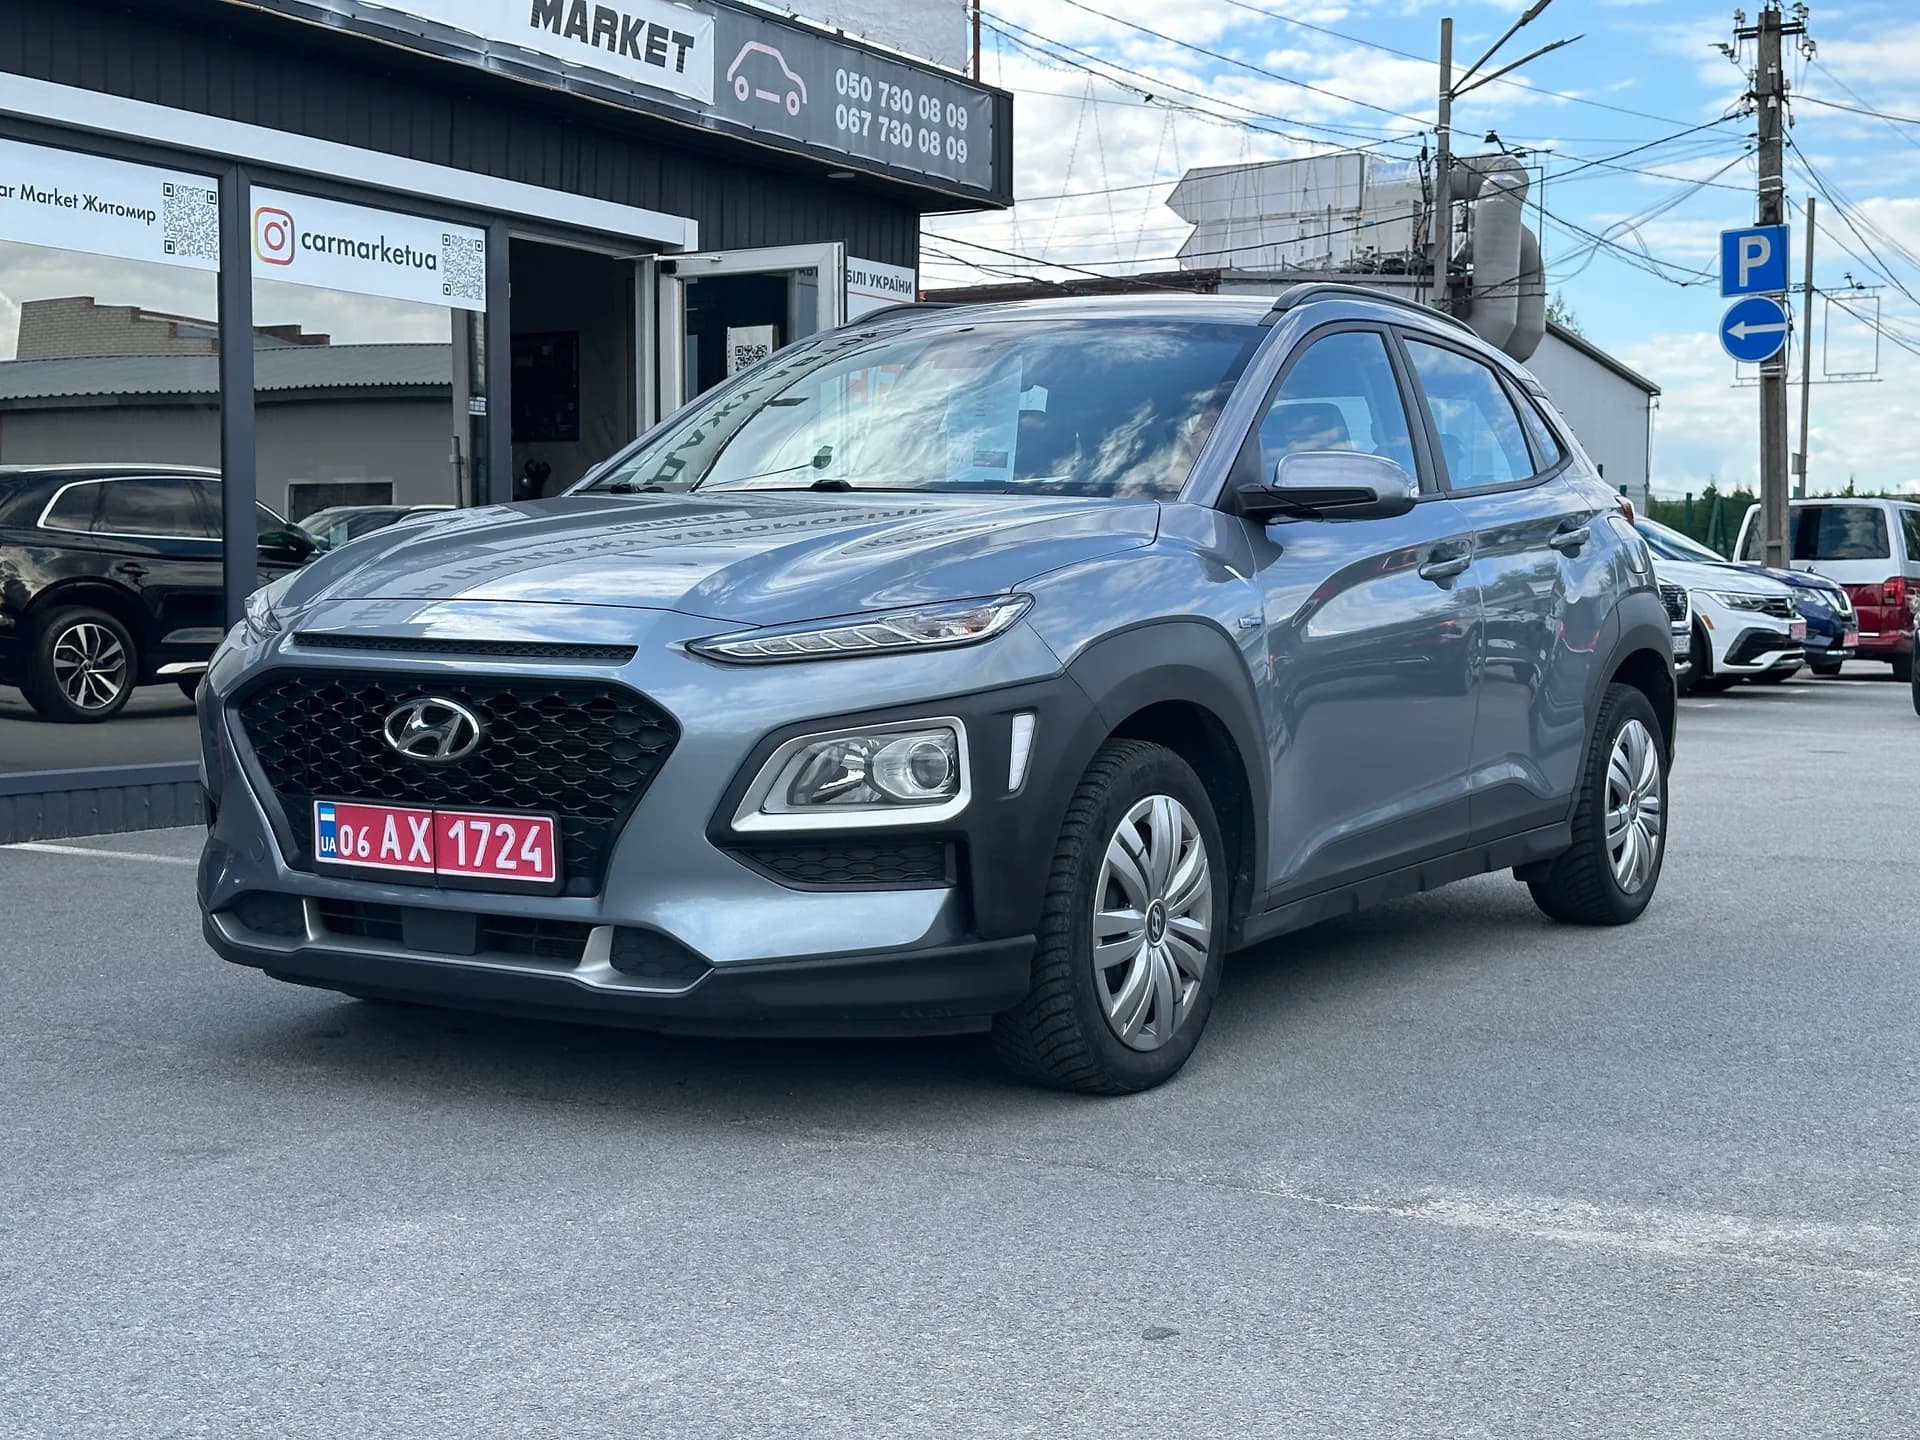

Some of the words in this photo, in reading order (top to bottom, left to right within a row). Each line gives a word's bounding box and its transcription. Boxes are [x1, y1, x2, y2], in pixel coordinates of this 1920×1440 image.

[530, 0, 695, 74] MARKET
[835, 68, 872, 102] 050
[878, 81, 913, 115] 730
[918, 94, 941, 123] 08
[946, 103, 968, 131] 09
[835, 104, 872, 137] 067
[878, 115, 913, 148] 730
[918, 127, 941, 156] 08
[945, 136, 968, 164] 09
[20, 183, 78, 209] Market
[83, 194, 157, 226] Житомир
[301, 231, 437, 271] carmarketua
[1739, 235, 1771, 287] P
[870, 275, 912, 295] УКРАЇНИ
[321, 836, 336, 853] UA
[339, 824, 371, 858] 06
[448, 820, 542, 873] 1724
